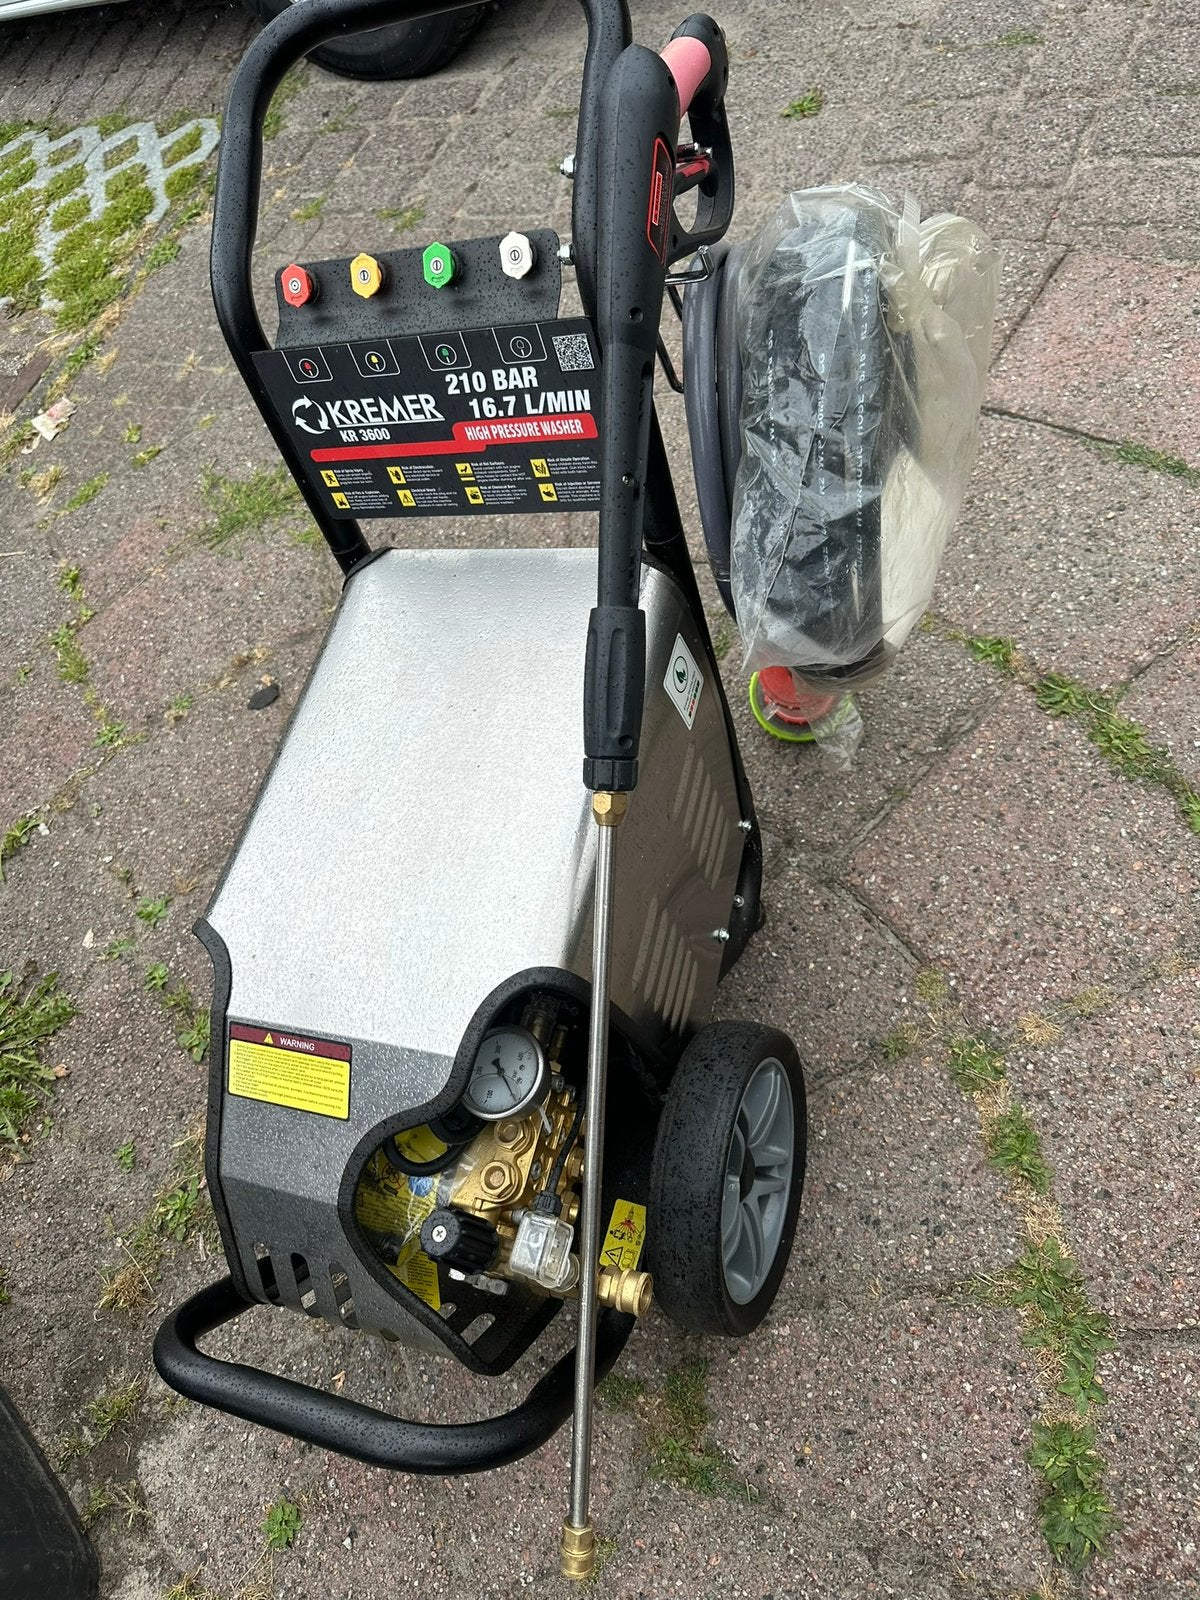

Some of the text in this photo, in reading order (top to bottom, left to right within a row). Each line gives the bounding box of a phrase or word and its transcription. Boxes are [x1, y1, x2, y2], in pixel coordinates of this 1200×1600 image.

[445, 366, 538, 395] 210 BAR
[325, 393, 444, 426] KREMER
[469, 389, 591, 419] 16.7 L/MIN
[856, 393, 866, 435] HOSE
[339, 427, 391, 442] KR 3600
[464, 419, 584, 441] HIGH PRESSURE WASHER
[855, 445, 864, 527] HYDRAULIC
[279, 1037, 315, 1051] WARNING
